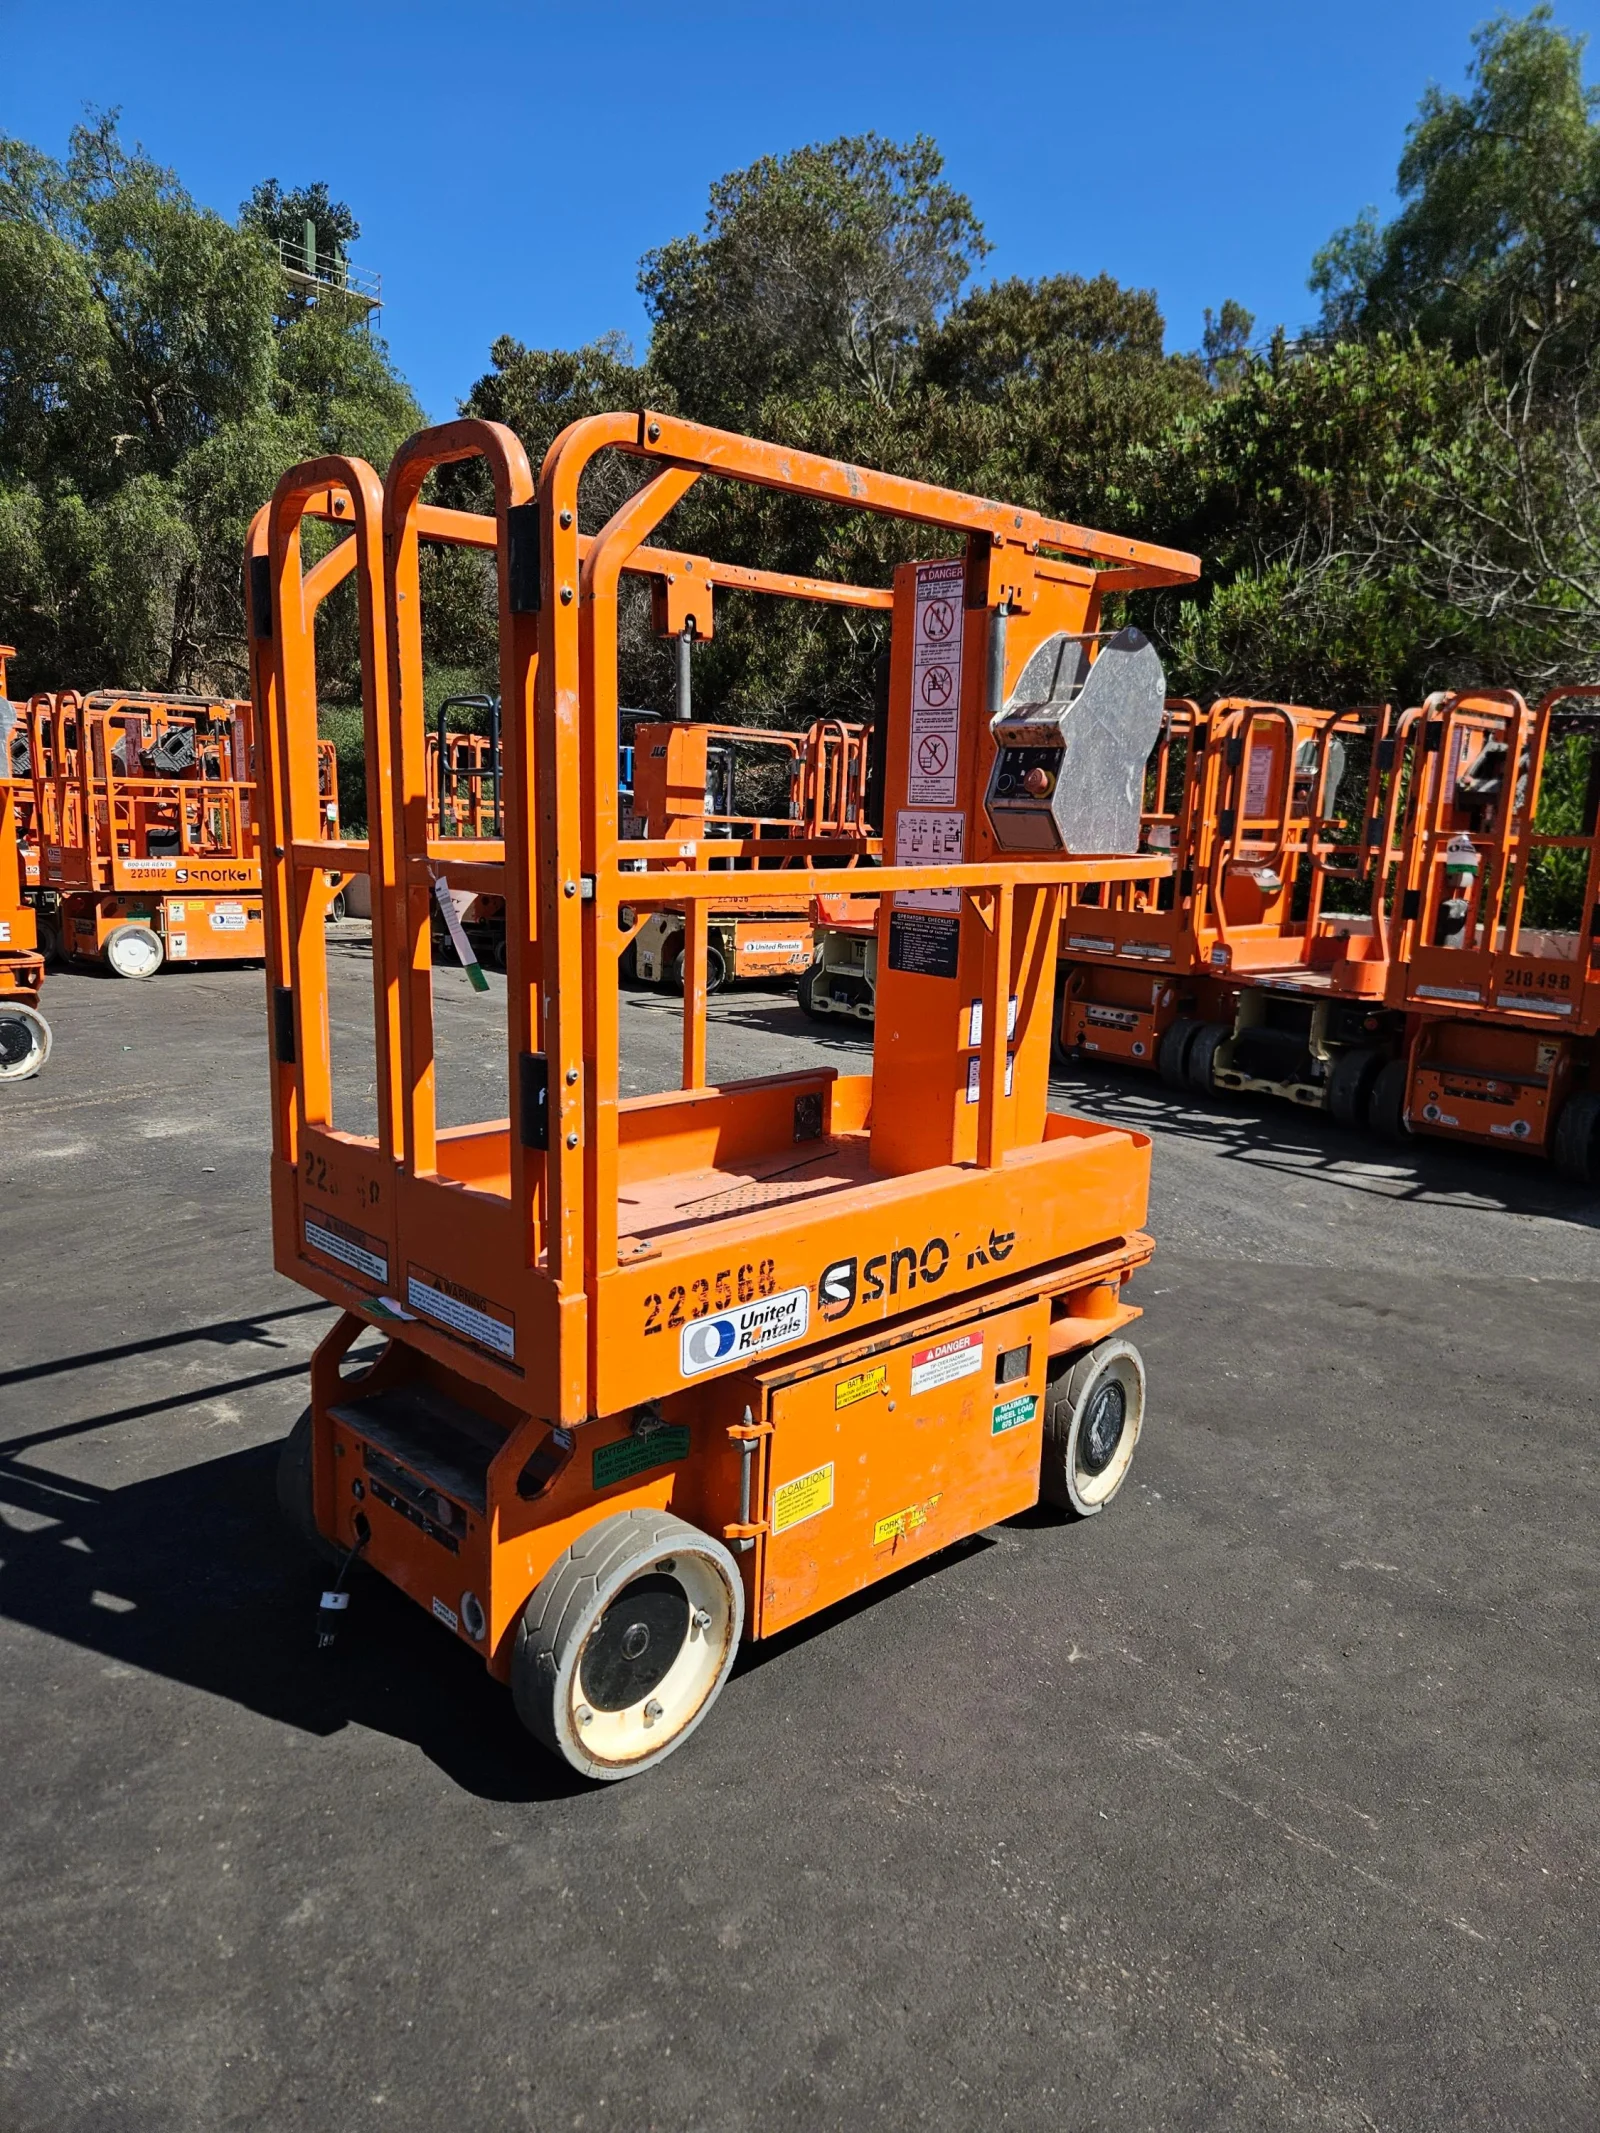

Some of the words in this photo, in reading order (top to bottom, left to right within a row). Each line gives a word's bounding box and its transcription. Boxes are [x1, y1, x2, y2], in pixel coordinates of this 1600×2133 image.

[929, 567, 962, 580] DANGER
[651, 747, 667, 757] JLG
[131, 869, 166, 878] 223012
[897, 913, 925, 921] OPERATORS
[928, 917, 954, 925] CHECKLIST
[445, 1281, 487, 1312] WARNING
[740, 1298, 798, 1330] United
[935, 1337, 970, 1357] DANGER
[995, 1410, 1016, 1424] WHEEL
[1018, 1403, 1034, 1415] LOAD
[1001, 1397, 1030, 1413] MAXIMUM
[597, 1442, 631, 1460] BATTERY
[788, 1470, 825, 1495] CAUTION
